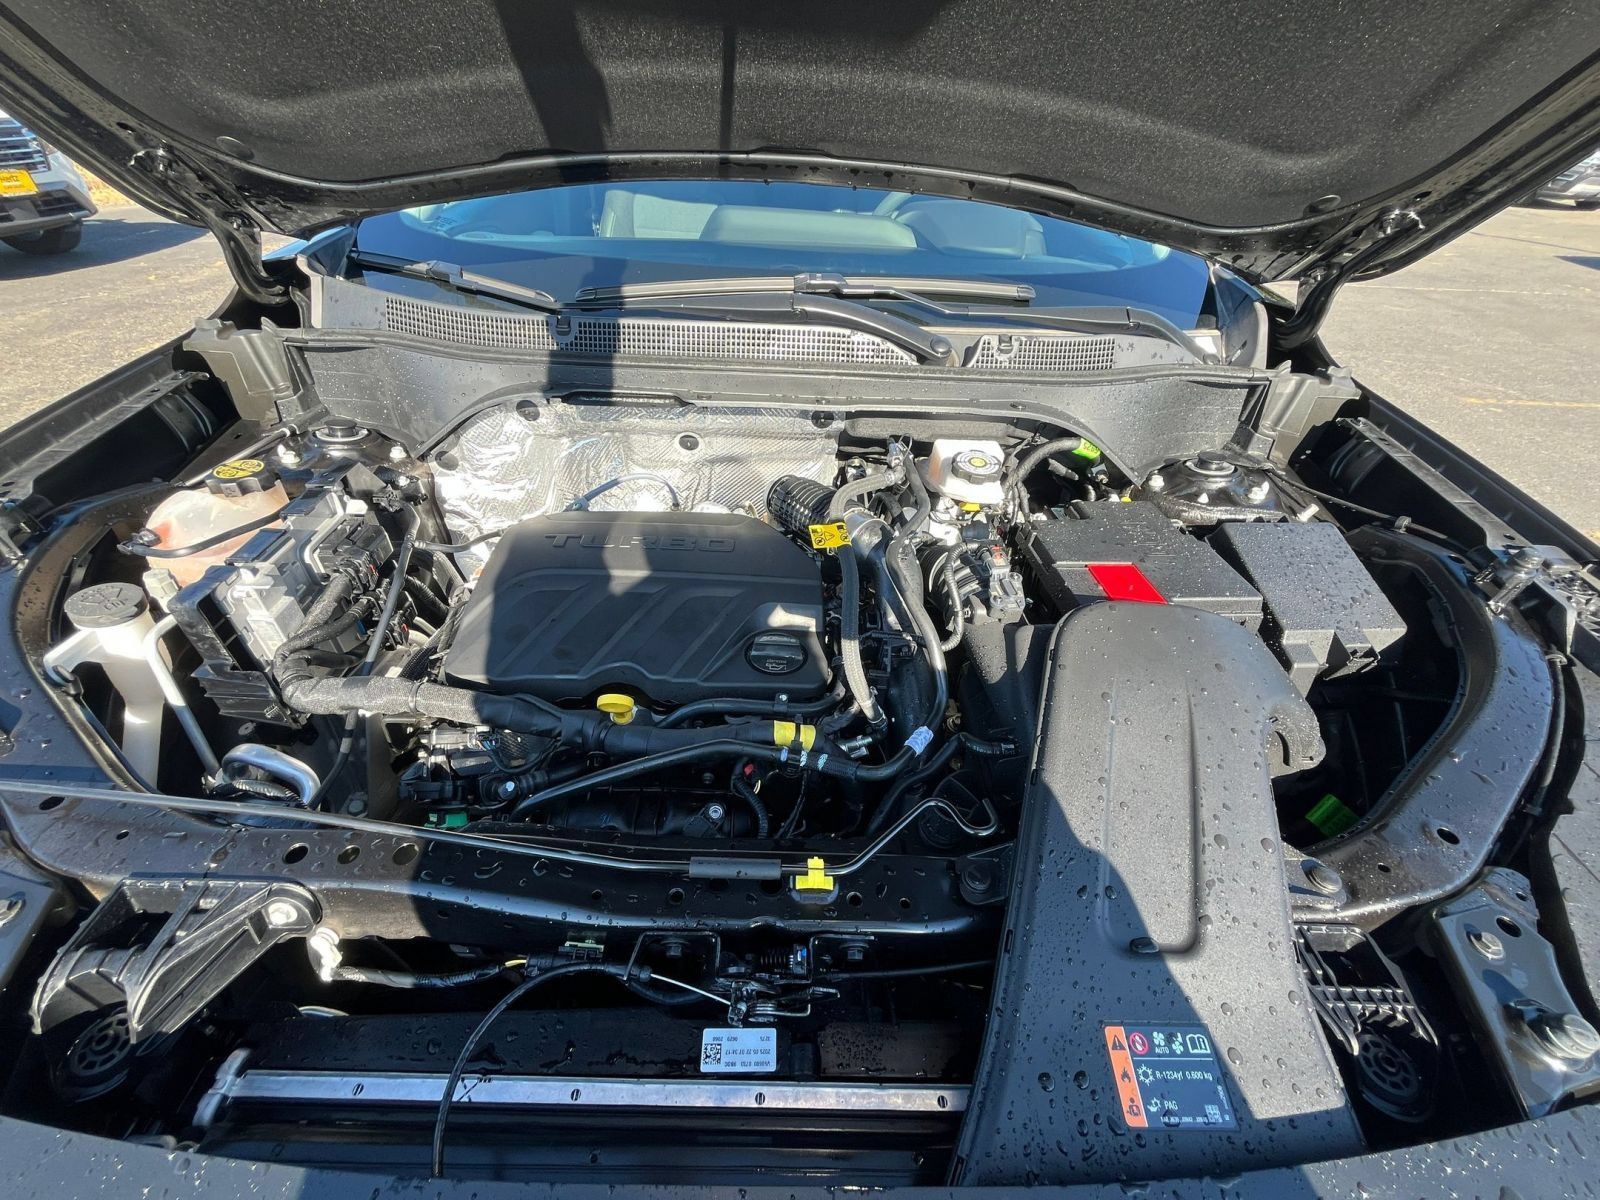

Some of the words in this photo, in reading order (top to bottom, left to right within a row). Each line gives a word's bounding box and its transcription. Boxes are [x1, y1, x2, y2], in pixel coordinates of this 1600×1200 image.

[545, 533, 735, 552] TURBO
[1155, 1046, 1170, 1054] AUTO
[1155, 1070, 1184, 1081] R-1234yf
[1164, 1100, 1179, 1110] PAG
